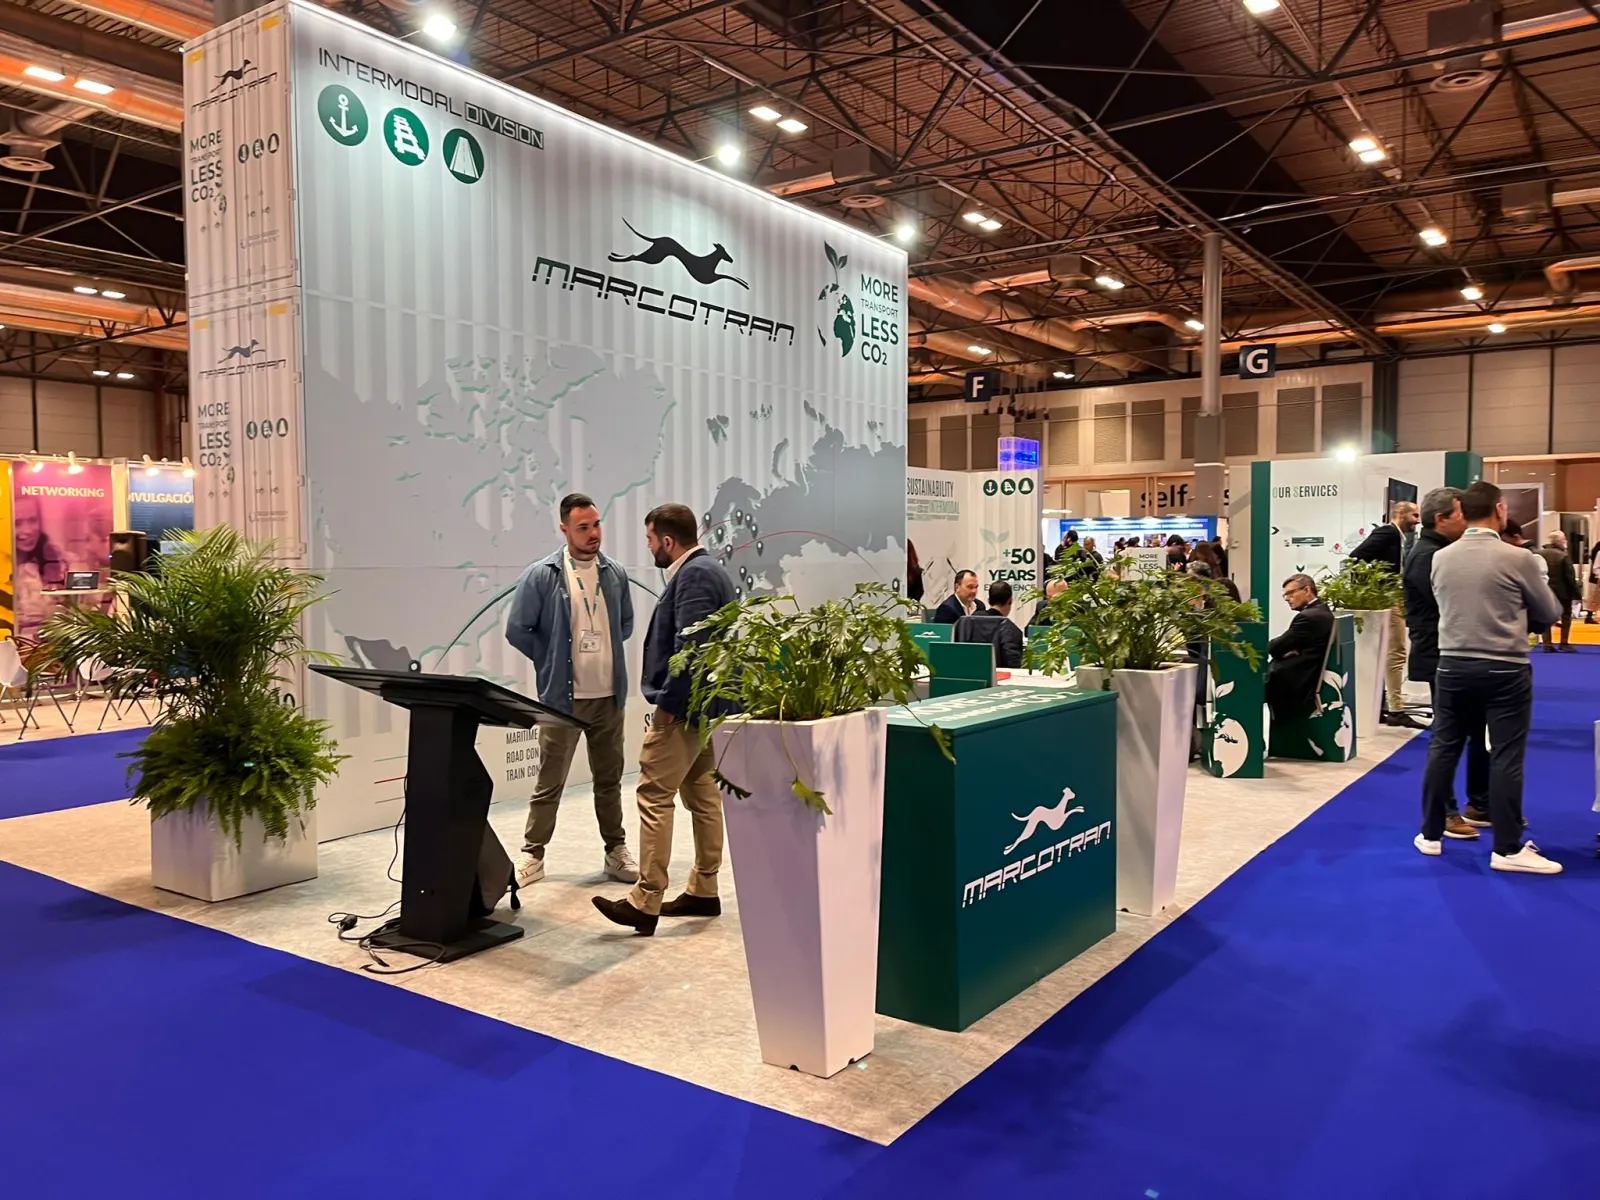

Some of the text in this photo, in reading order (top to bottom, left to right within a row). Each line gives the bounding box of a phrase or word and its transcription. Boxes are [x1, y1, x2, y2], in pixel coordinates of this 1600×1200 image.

[319, 47, 462, 117] INTERMODAL
[466, 103, 544, 149] DIVISION
[190, 129, 222, 153] MORE
[191, 160, 224, 185] LESS
[861, 274, 898, 303] MORE
[532, 256, 795, 346] MARCOTRAN
[861, 298, 899, 318] TRANSPORT
[861, 314, 899, 345] LESS
[1246, 348, 1270, 374] G
[972, 376, 985, 398] F
[198, 402, 230, 418] MORE
[199, 431, 232, 450] LESS
[21, 485, 105, 498] NETWORKING
[907, 477, 955, 497] SUSTAINABILITY
[1272, 484, 1338, 499] OUR SERVICES
[128, 491, 194, 504] IVULGACIÓ
[1003, 548, 1036, 564] +50
[989, 569, 1036, 581] YEARS
[506, 728, 538, 744] MARITIME
[506, 749, 524, 764] ROAD
[506, 767, 525, 782] TRAIN
[962, 821, 1111, 908] MARCOTRAN
